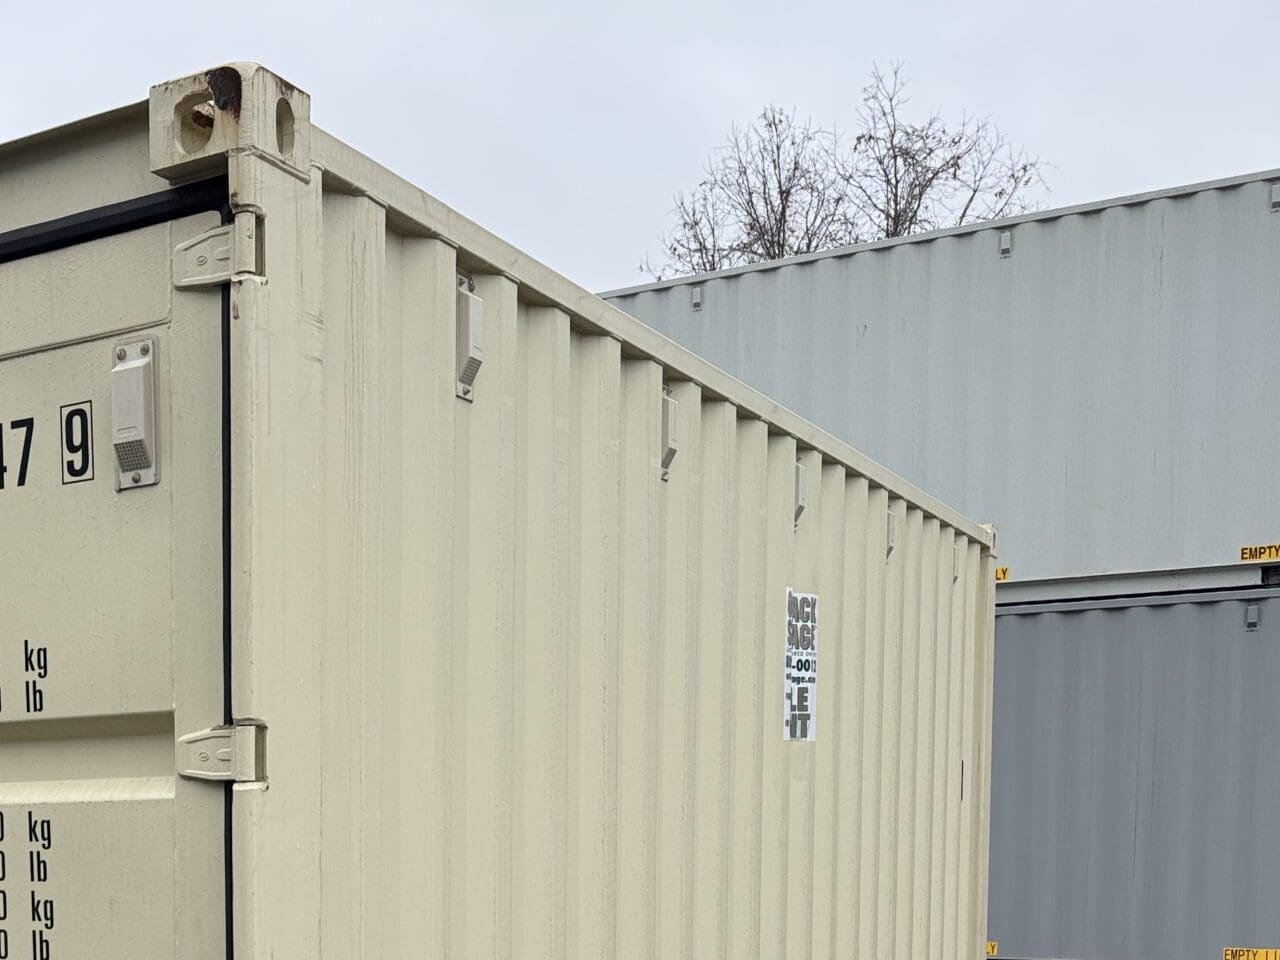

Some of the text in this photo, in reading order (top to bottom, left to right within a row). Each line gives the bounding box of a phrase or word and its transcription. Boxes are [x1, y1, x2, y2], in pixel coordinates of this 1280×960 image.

[64, 407, 90, 478] 9
[24, 640, 49, 678] kg
[25, 680, 44, 713] lb
[28, 811, 52, 850] kg
[29, 851, 48, 882] lb
[30, 891, 55, 929] kg
